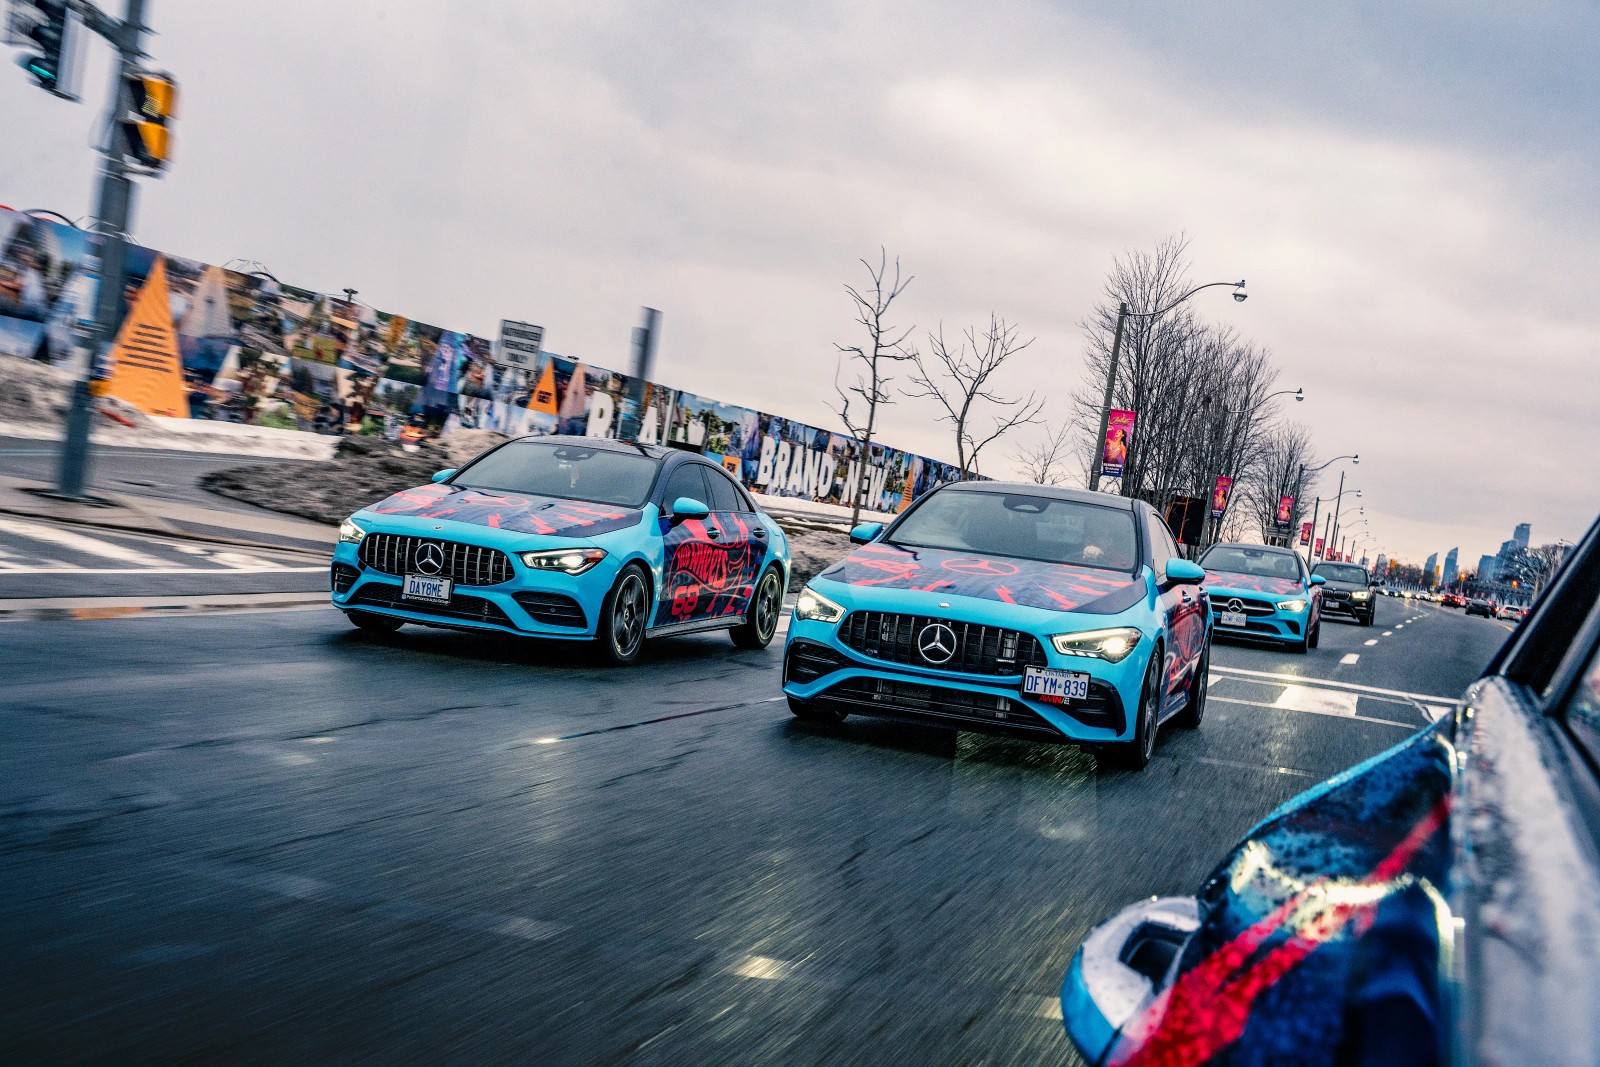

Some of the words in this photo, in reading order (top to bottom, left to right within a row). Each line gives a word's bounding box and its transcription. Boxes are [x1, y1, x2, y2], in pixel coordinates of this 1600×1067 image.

[410, 580, 442, 597] DAY8ME
[1026, 675, 1058, 694] DFYM
[1063, 679, 1087, 697] 839
